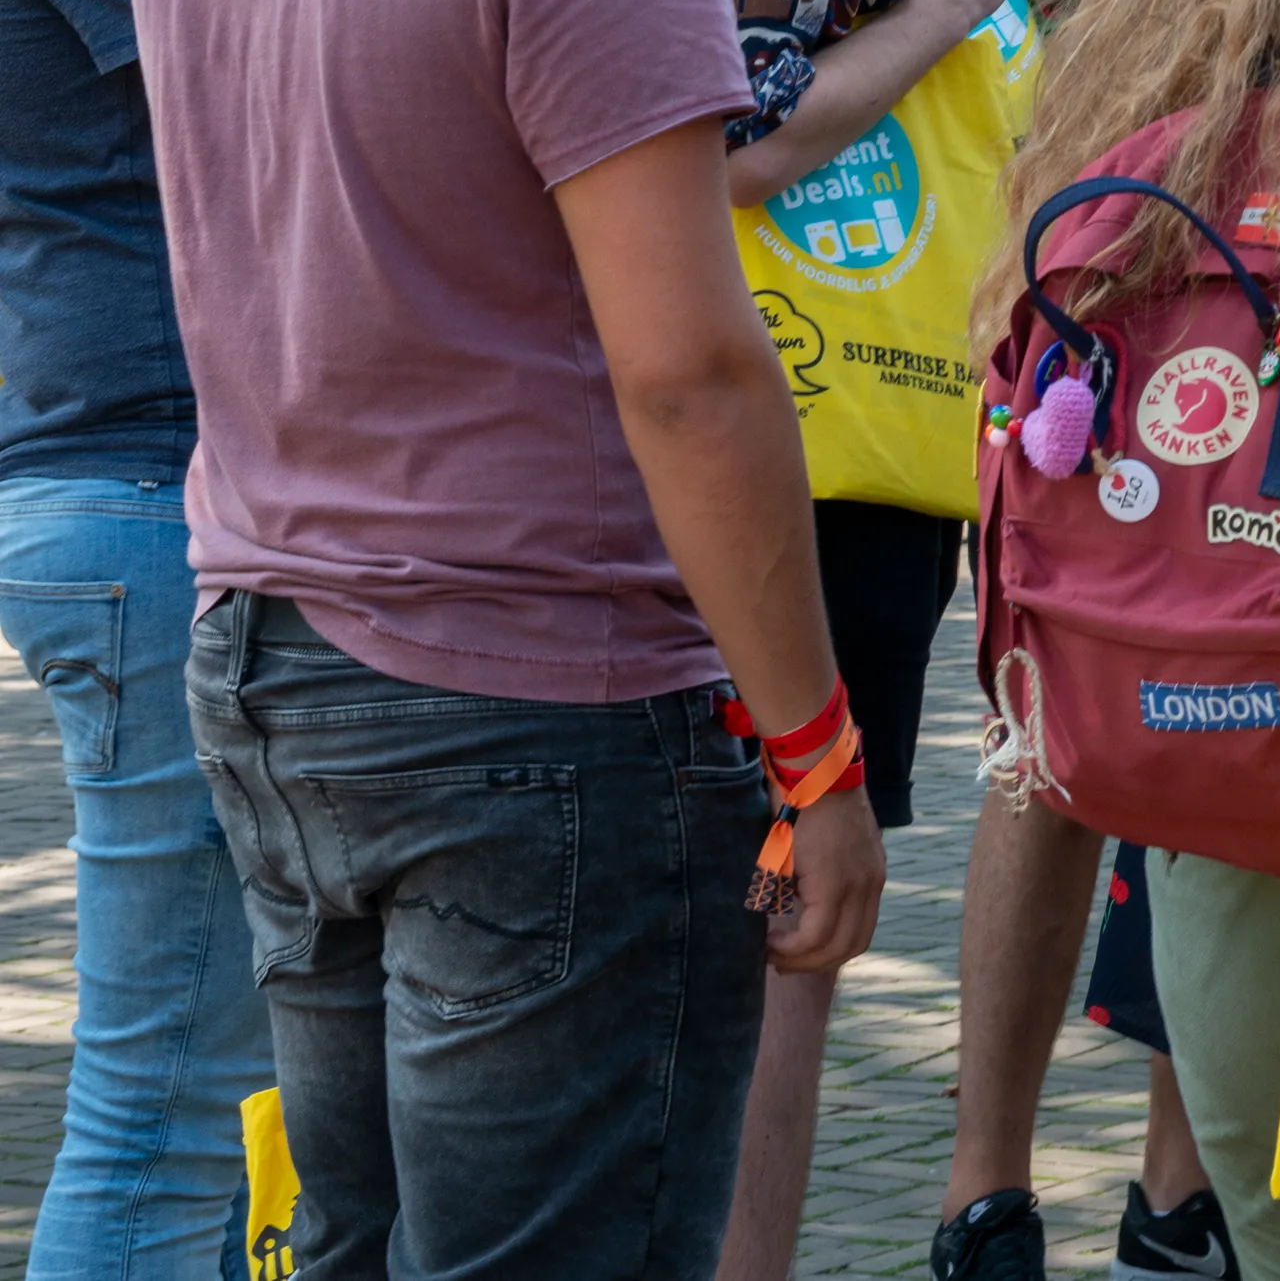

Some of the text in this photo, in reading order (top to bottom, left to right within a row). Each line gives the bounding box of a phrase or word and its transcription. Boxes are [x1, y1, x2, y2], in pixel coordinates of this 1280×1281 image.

[780, 161, 903, 211] Deals.nl
[753, 224, 793, 265] HUUR
[796, 258, 877, 293] VOORDELIG
[842, 341, 977, 387] SURPRISE BA
[879, 370, 965, 399] AMSTERDAM
[1107, 491, 1121, 503] I
[1120, 476, 1143, 509] VLC
[1147, 691, 1275, 723] LONDON
